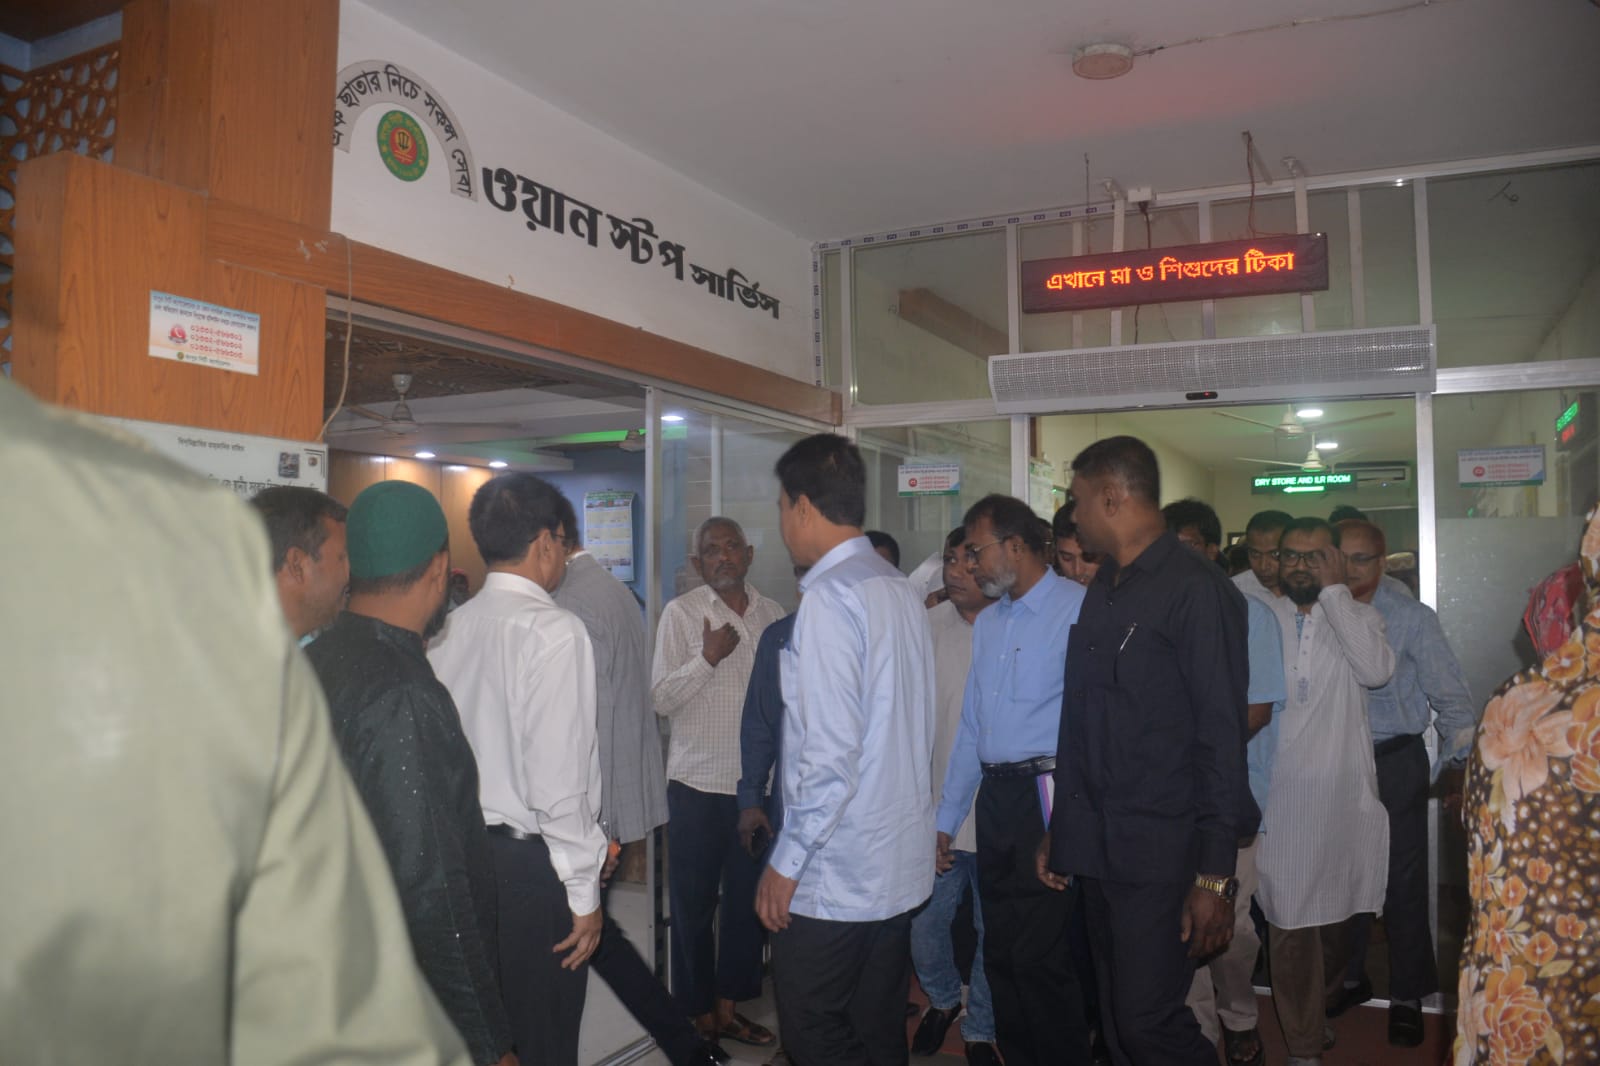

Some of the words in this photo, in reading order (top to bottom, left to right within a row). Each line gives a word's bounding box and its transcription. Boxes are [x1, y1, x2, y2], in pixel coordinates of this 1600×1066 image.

[336, 69, 382, 108] ছাতার
[384, 63, 421, 100] নিচে
[423, 90, 458, 142] সকল
[451, 148, 473, 197] সেবা
[482, 167, 602, 248] ওয়ান
[606, 216, 686, 281] স্টপ
[689, 263, 780, 320] সার্ভিস
[1046, 269, 1106, 291] এখানে
[1110, 266, 1132, 286] মা
[1136, 265, 1154, 281] ও
[1159, 256, 1240, 282] শিশুদের
[1244, 248, 1295, 274] টিকা
[1255, 478, 1270, 487] DRY
[1271, 477, 1297, 486] STORE
[1298, 476, 1313, 485] AND
[1327, 474, 1351, 483] ROOM
